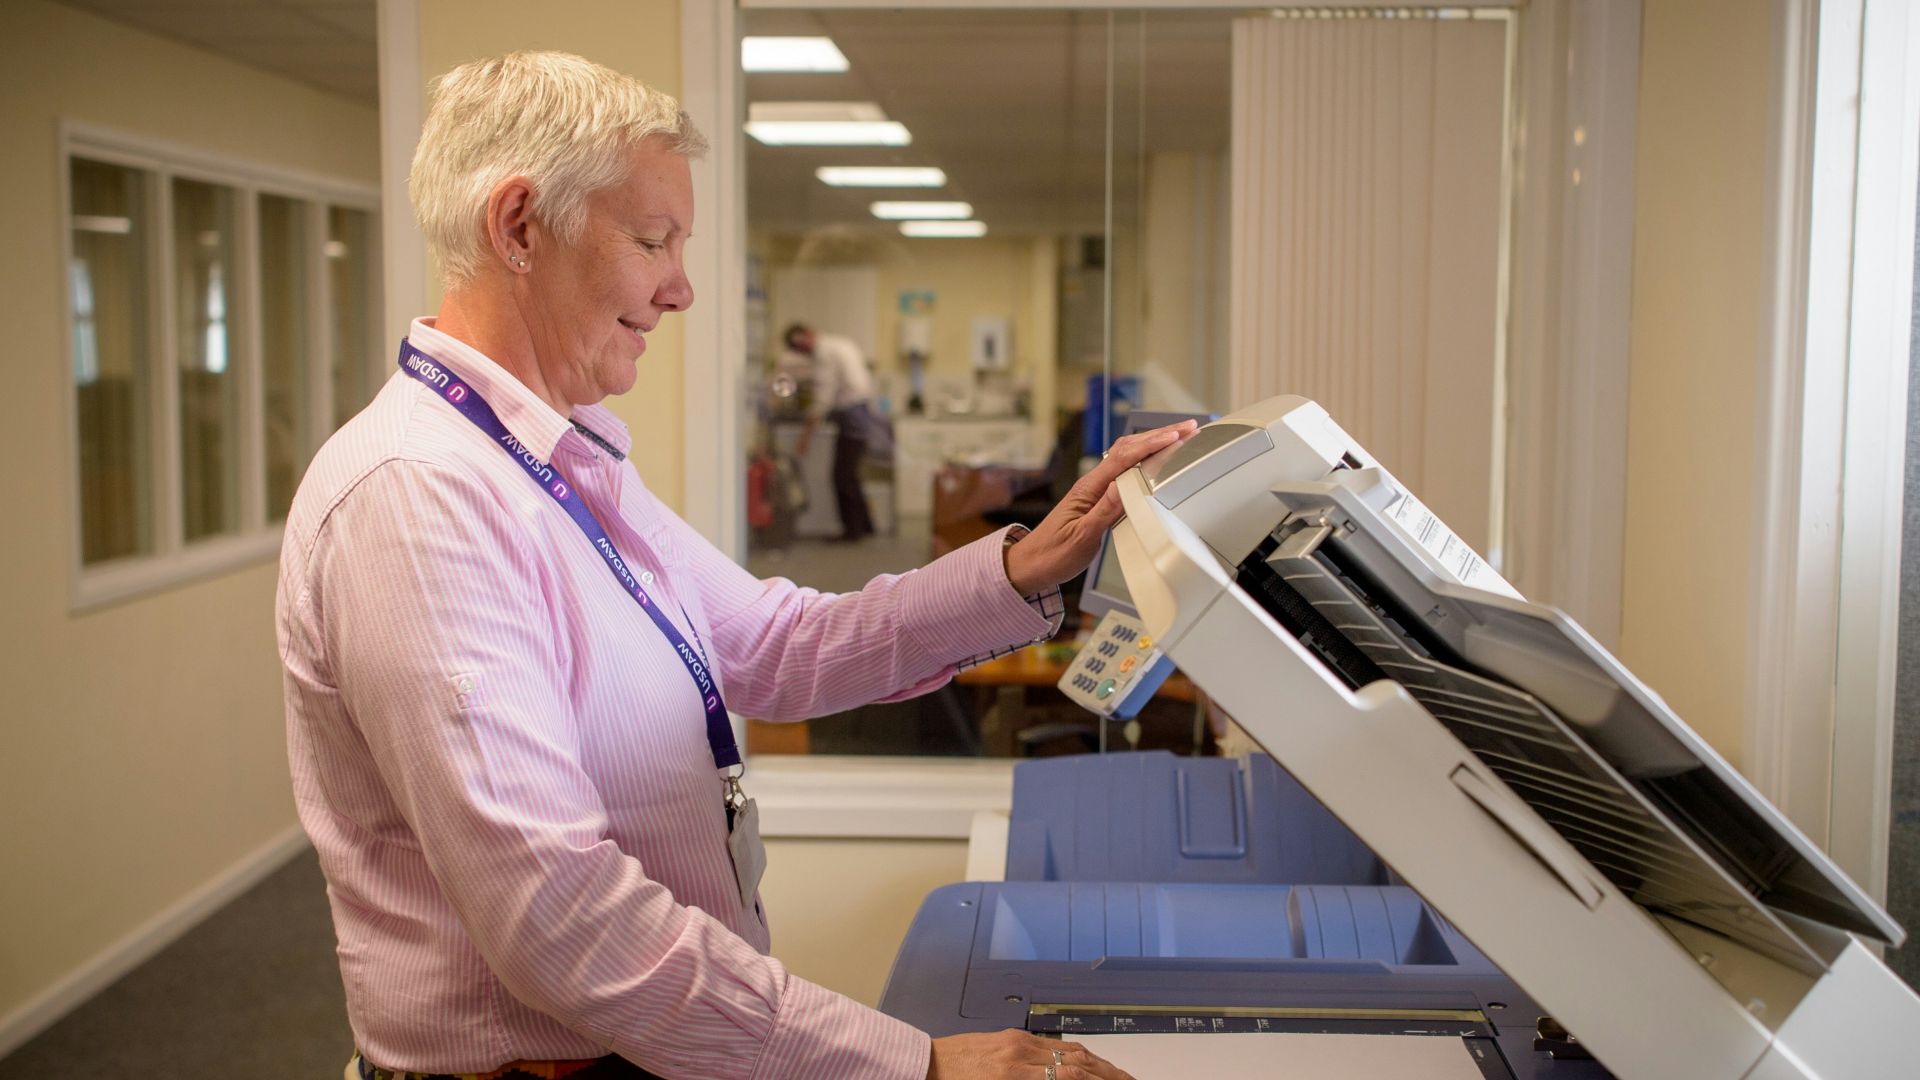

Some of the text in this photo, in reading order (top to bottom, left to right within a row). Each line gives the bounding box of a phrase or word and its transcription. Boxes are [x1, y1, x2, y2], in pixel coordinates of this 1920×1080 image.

[406, 353, 465, 401] U USDAW
[501, 434, 567, 498] U USDAW
[597, 537, 647, 604] U USDAW
[678, 643, 711, 694] USDAW
[706, 695, 717, 710] U
